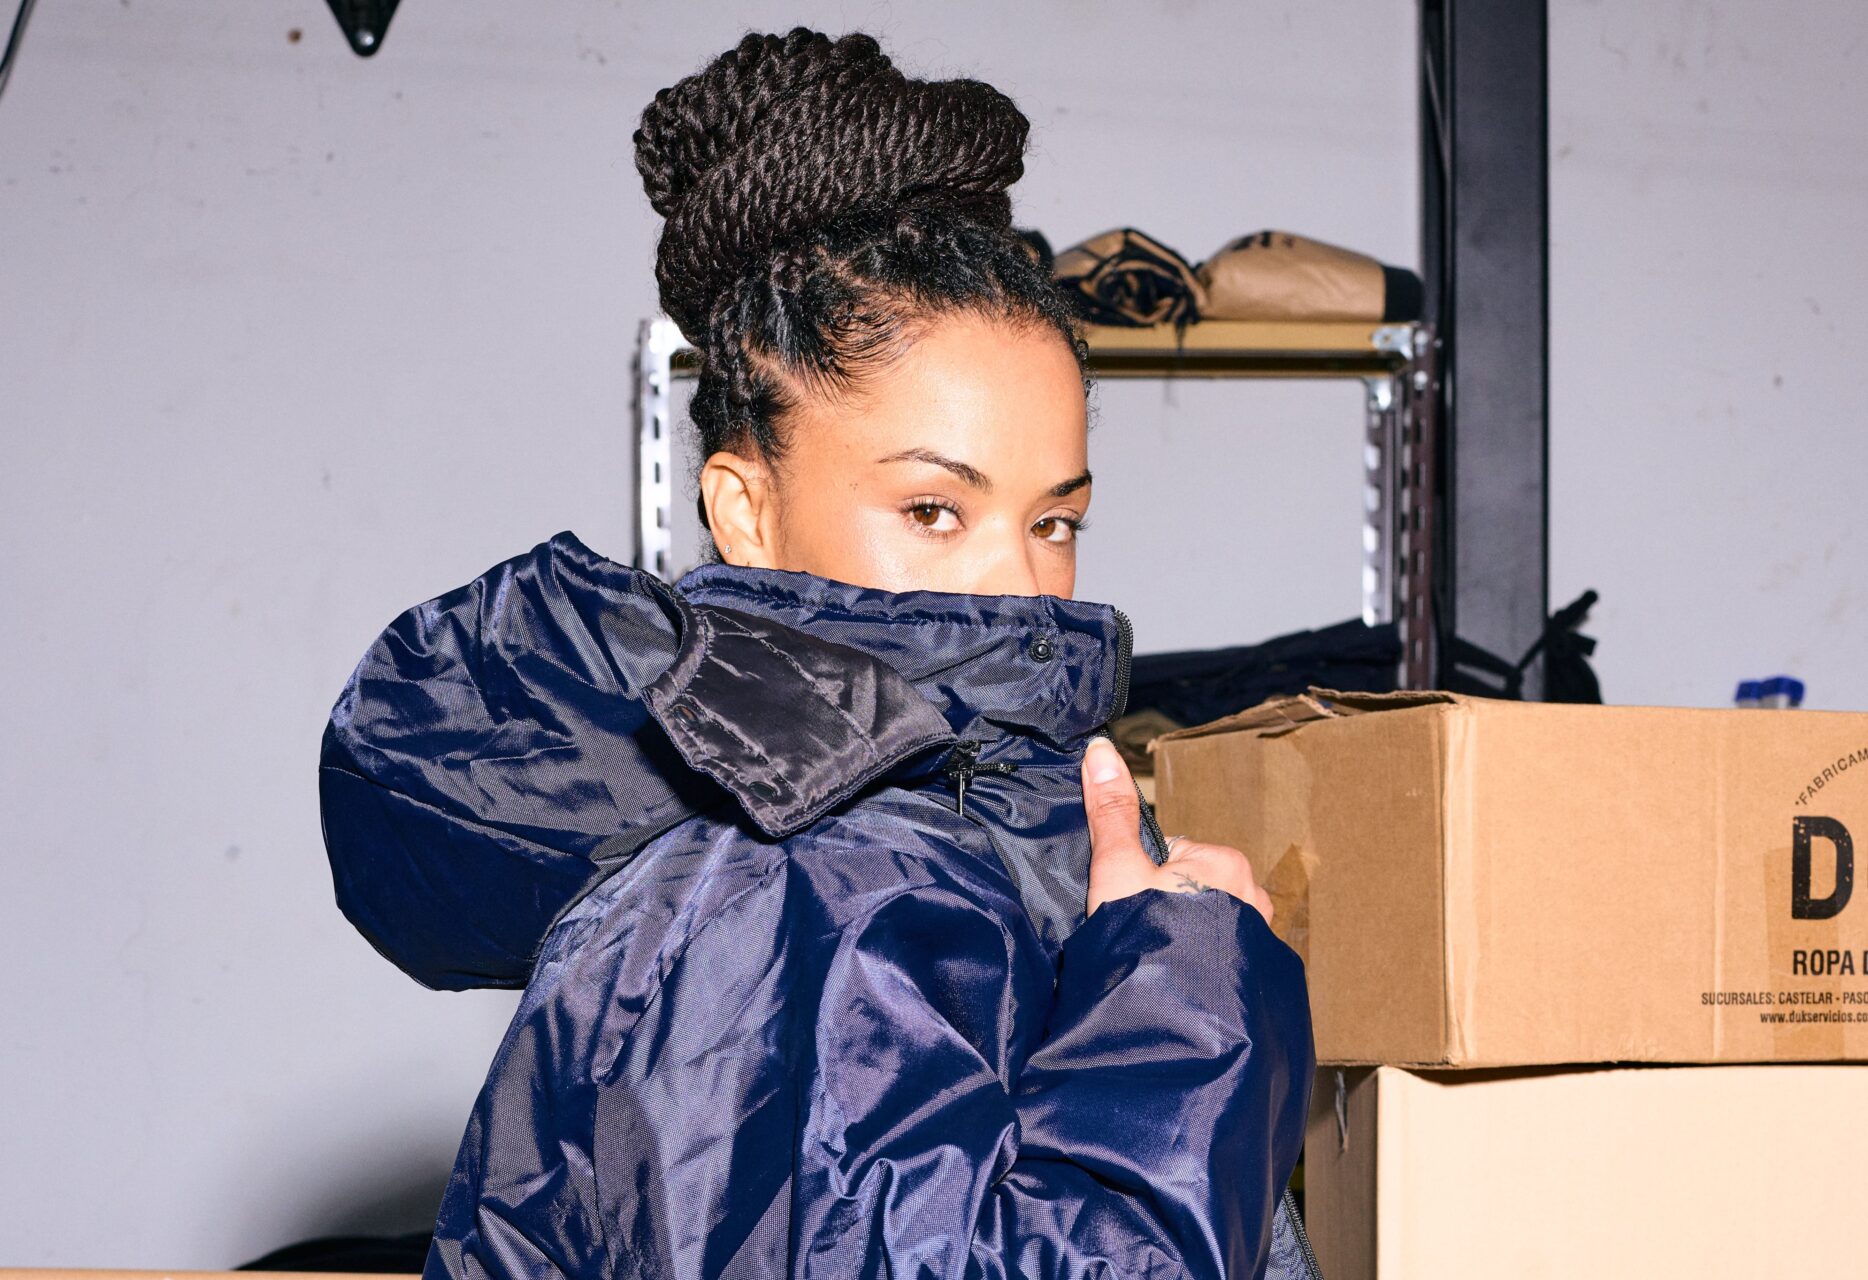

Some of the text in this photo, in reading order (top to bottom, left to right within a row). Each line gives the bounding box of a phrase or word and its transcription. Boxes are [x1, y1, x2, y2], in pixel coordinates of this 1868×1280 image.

[1793, 949, 1855, 976] ROPA
[1701, 992, 1776, 1005] SUCURSALES:
[1779, 992, 1833, 1005] CASTELAR
